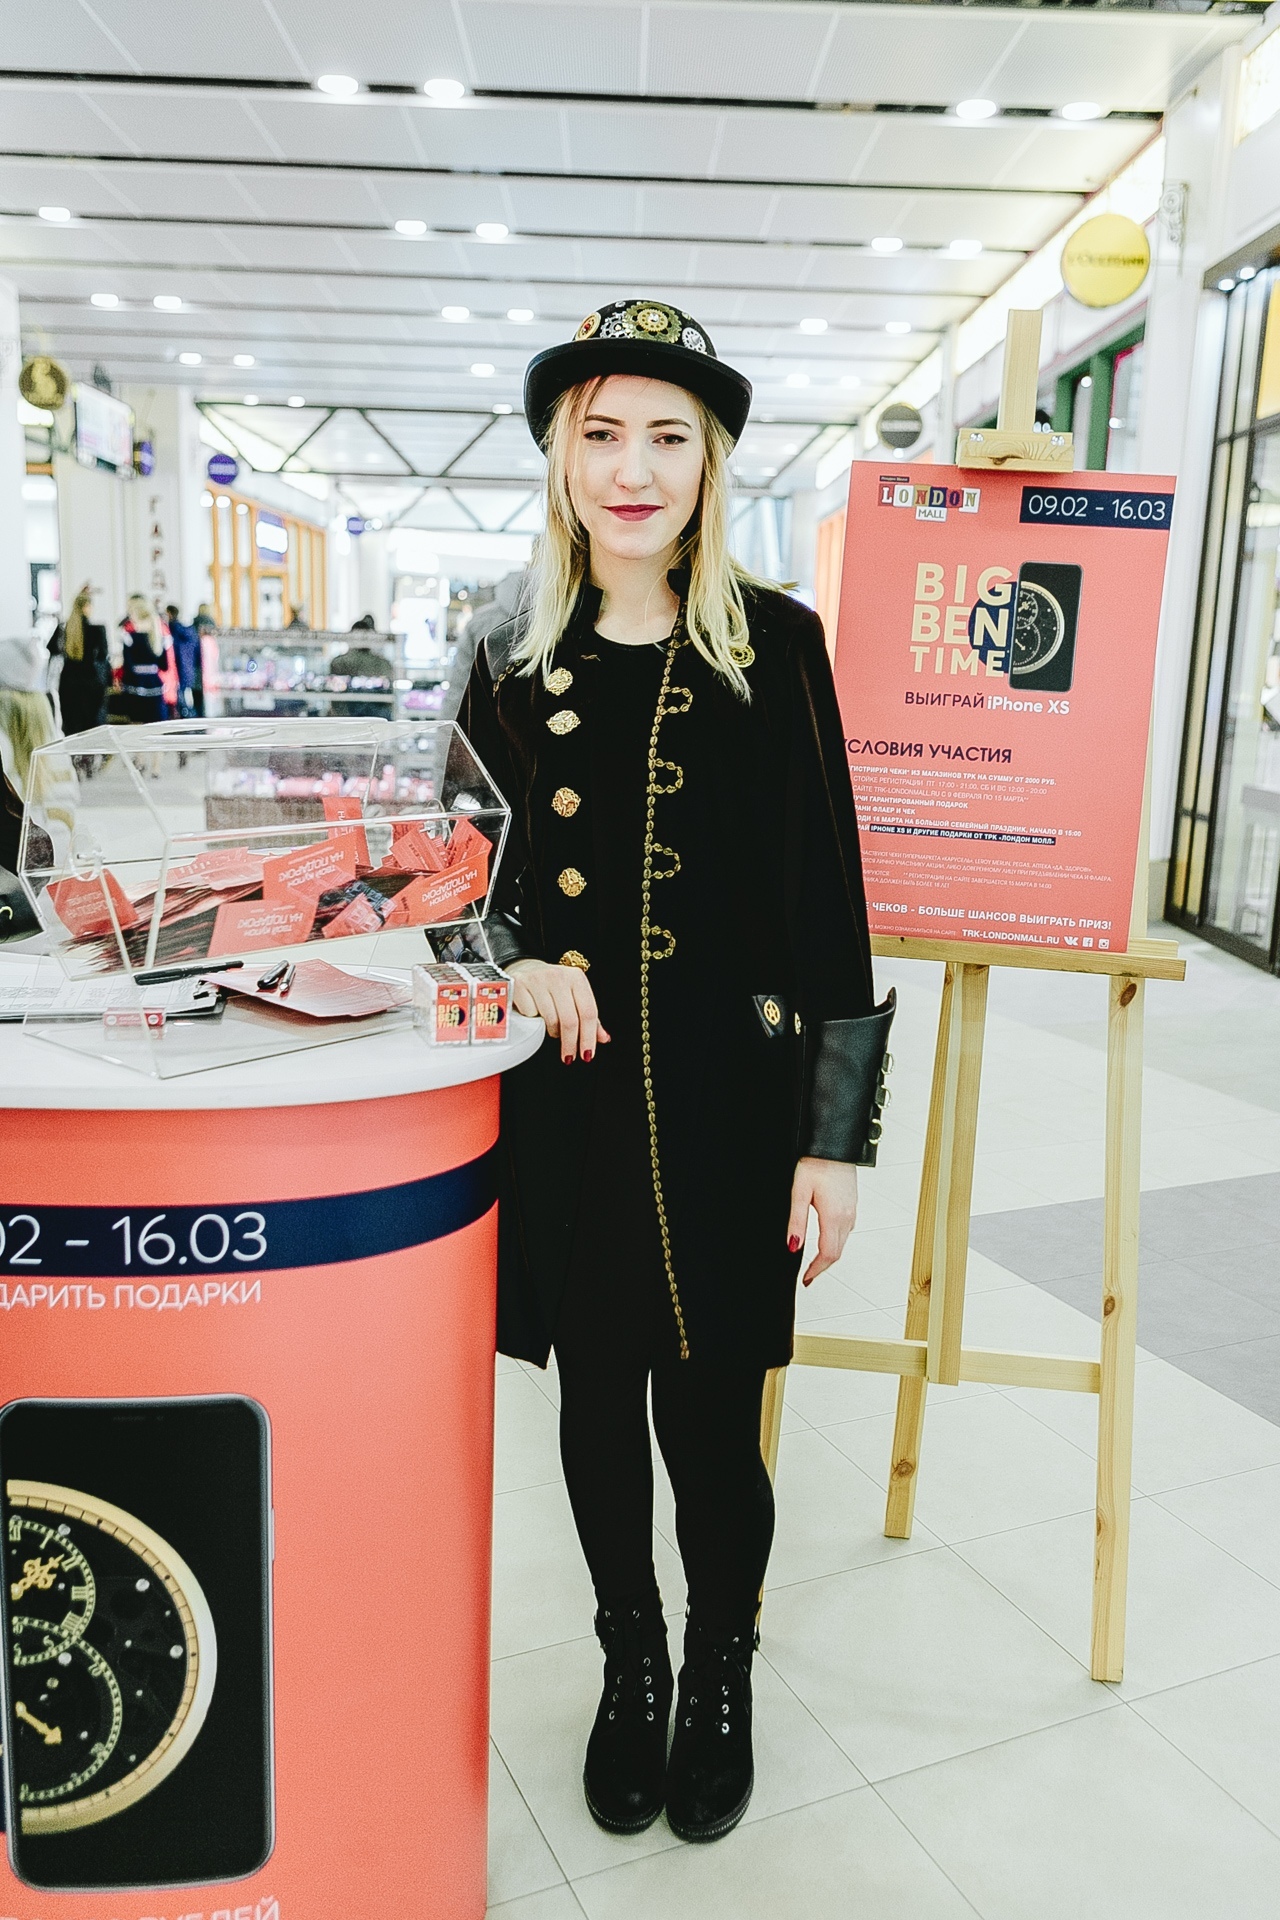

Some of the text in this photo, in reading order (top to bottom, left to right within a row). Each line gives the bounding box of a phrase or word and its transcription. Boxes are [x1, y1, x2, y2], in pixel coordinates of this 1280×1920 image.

[880, 485, 979, 509] LONDON
[918, 509, 944, 519] MALL
[1028, 494, 1088, 517] 09.02
[1112, 499, 1166, 521] 16.03
[914, 562, 1013, 606] BIG
[910, 603, 1010, 648] BEN
[909, 645, 1006, 678] TIME
[904, 691, 1070, 714] ВЫИГРАЙ iPhone XS
[844, 738, 1012, 764] СЛОВИЯ УЧАСТИЯ
[854, 775, 878, 784] СТОЙКЕ
[880, 777, 924, 787] РЕГИСТРАЦИИ
[922, 769, 961, 779] МАГАЗИНОВ
[963, 772, 976, 780] ТРК
[988, 774, 1013, 782] СУММУ
[853, 784, 872, 793] САЙТЕ
[874, 786, 940, 797] TRK-LONDONMALL.RU
[870, 795, 934, 806] ГАРАНТИРОВАННЫЙ
[936, 800, 968, 809] ПОДАРОК
[882, 816, 903, 824] МАРТА
[916, 818, 949, 827] БОЛЬШОЙ
[950, 821, 988, 830] СЕМЕЙНЫЙ
[1029, 827, 1056, 836] НАЧАЛО
[912, 828, 938, 836] ДРУГИЕ
[940, 830, 972, 839] ПОДАРКИ
[466, 869, 478, 880] НА
[872, 902, 908, 914] ЧЕКОВ
[918, 905, 965, 918] БОЛЬШЕ
[968, 910, 1016, 922] ШАНСОВ
[1020, 914, 1076, 927] ВЫИГРАТЬ
[1078, 918, 1112, 930] ПРИЗ!
[962, 928, 1060, 944] TRK-LONDONMALL.RU
[438, 1004, 460, 1014] BIG
[477, 1002, 498, 1012] BIG
[0, 1214, 42, 1265] 2
[112, 1211, 268, 1266] 16.03
[114, 1279, 261, 1312] ПОДАРКИ
